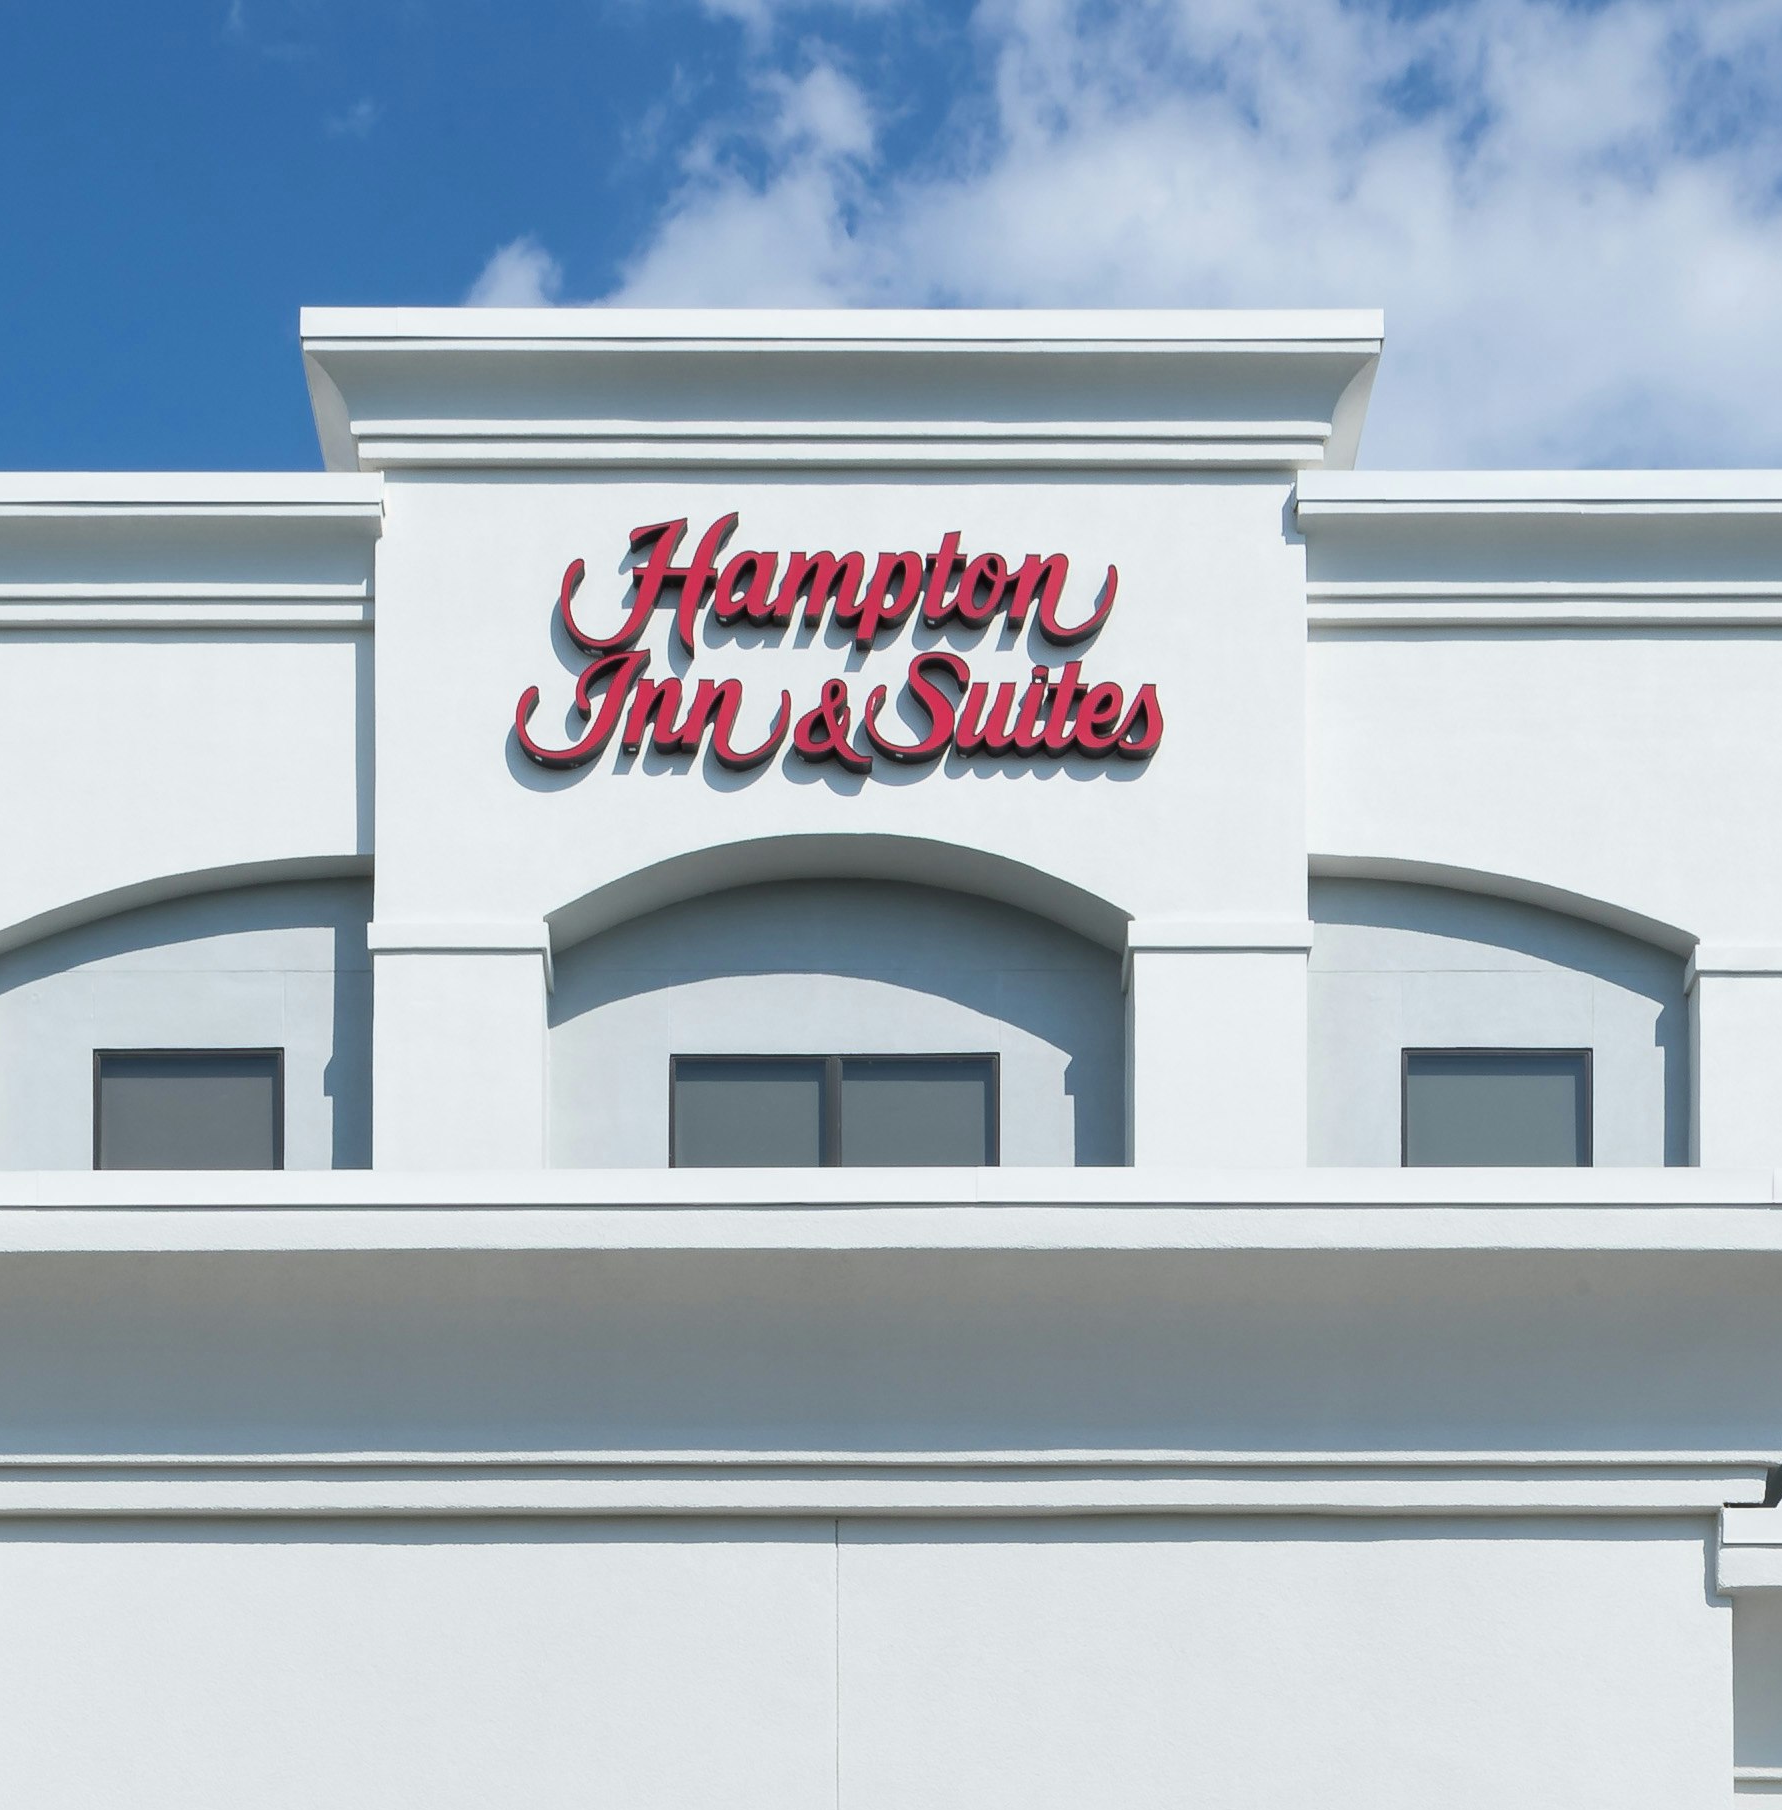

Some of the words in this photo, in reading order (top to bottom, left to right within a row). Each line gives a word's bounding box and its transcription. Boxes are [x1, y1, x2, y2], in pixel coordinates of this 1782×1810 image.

[560, 510, 1119, 659] Hampton
[515, 648, 790, 770] Inn
[793, 677, 873, 775] &
[865, 651, 1165, 764] Suites
